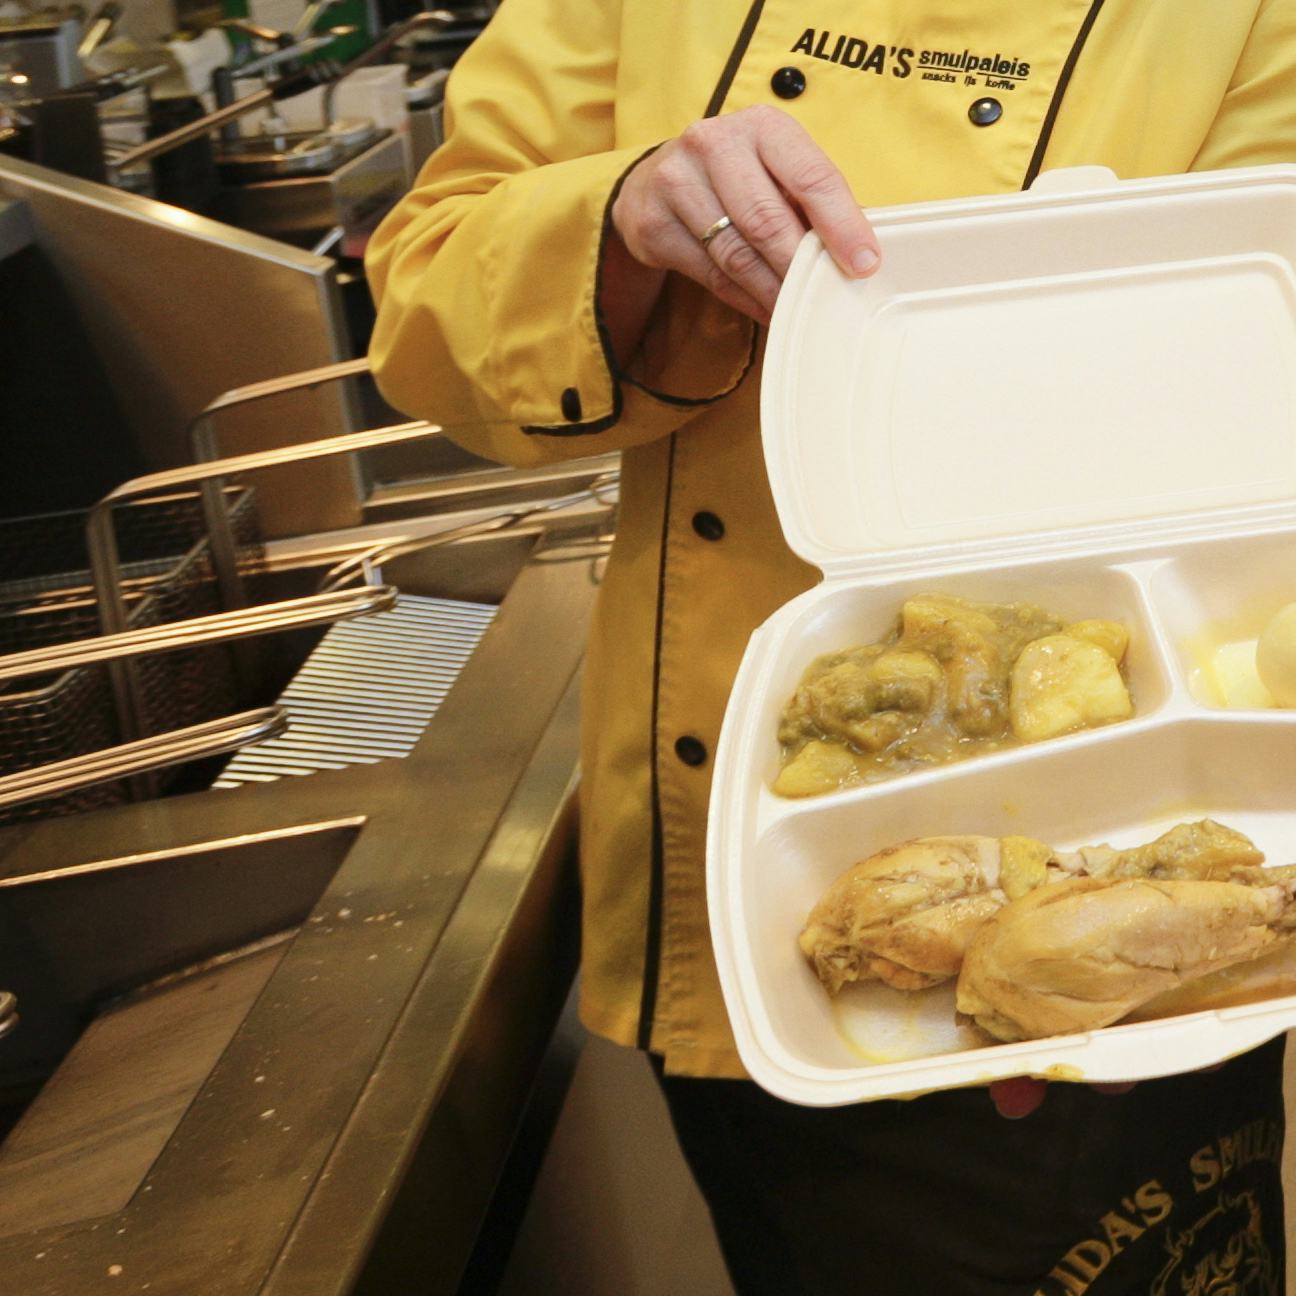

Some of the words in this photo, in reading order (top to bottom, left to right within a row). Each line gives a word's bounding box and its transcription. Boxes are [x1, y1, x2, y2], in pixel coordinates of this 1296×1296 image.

[790, 28, 914, 79] ALIDA'S
[919, 49, 1030, 77] smulpaleis
[921, 71, 956, 84] snacks
[985, 75, 1016, 91] koffie
